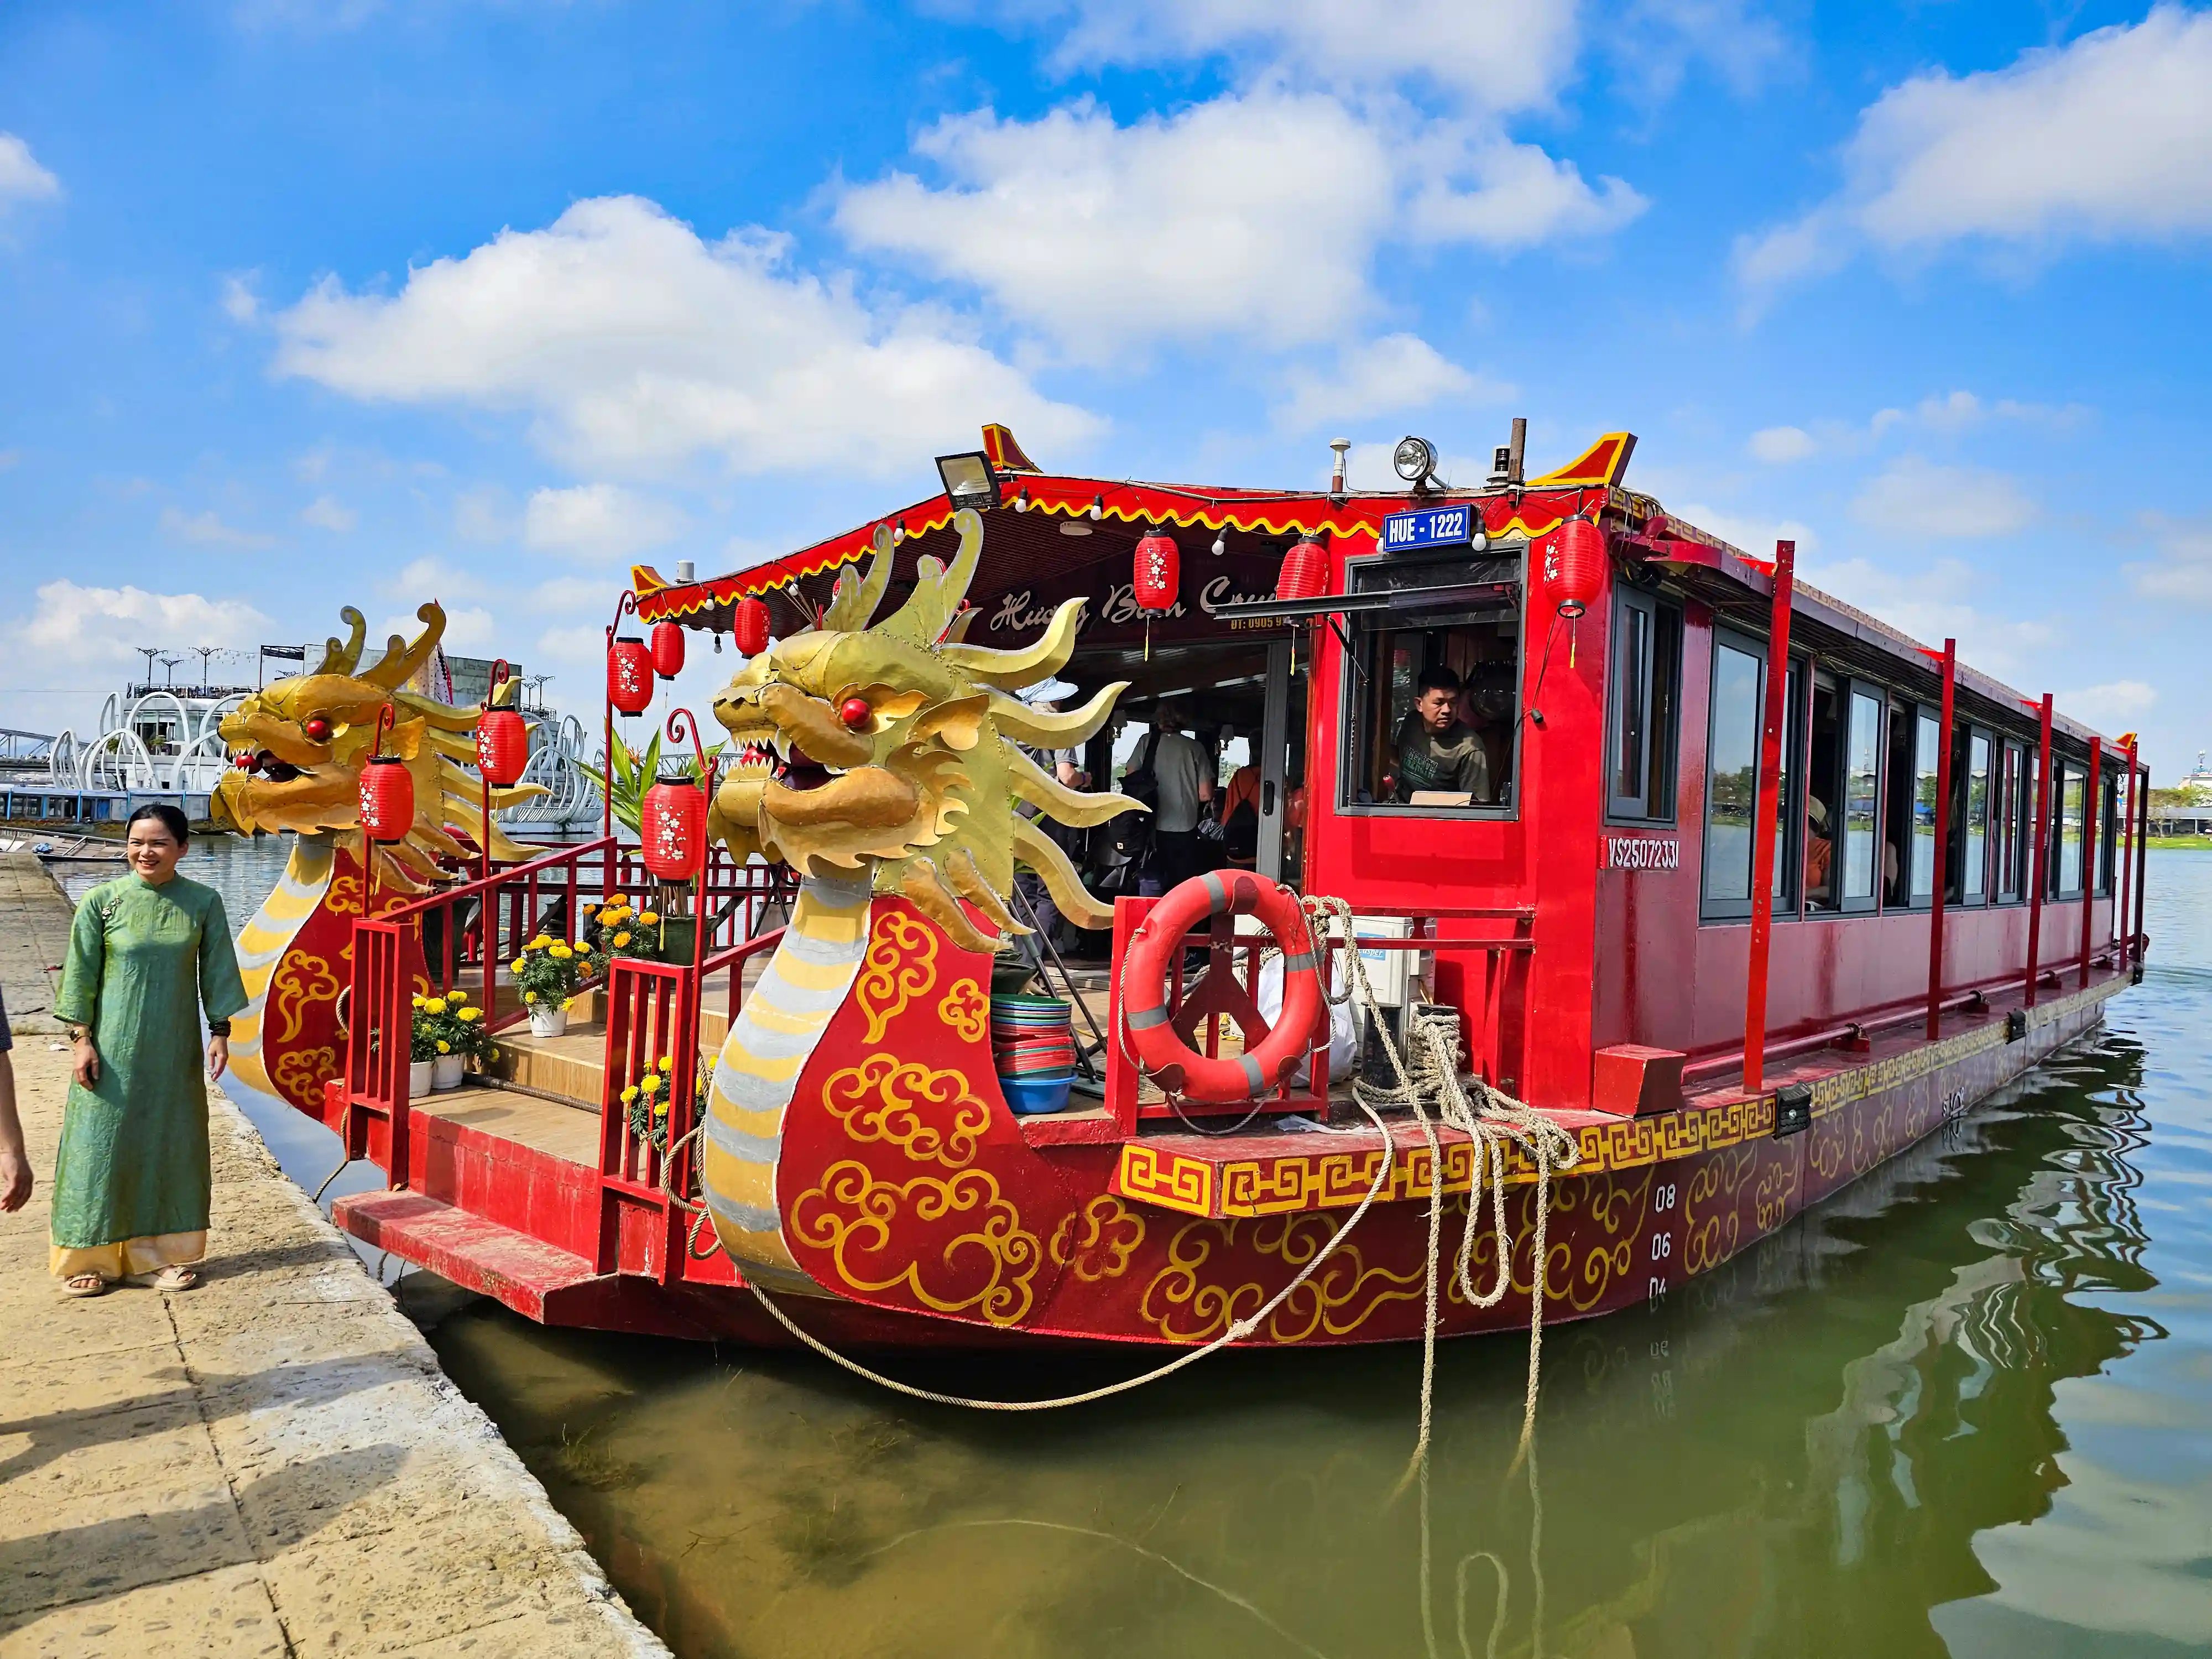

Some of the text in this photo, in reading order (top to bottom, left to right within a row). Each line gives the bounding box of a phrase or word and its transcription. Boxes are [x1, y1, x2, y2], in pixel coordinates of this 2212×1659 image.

[1389, 518, 1416, 543] HUE
[1429, 512, 1463, 539] 1222
[1248, 617, 1273, 628] 0905
[1655, 1183, 1676, 1213] 08
[1651, 1232, 1671, 1260] 06
